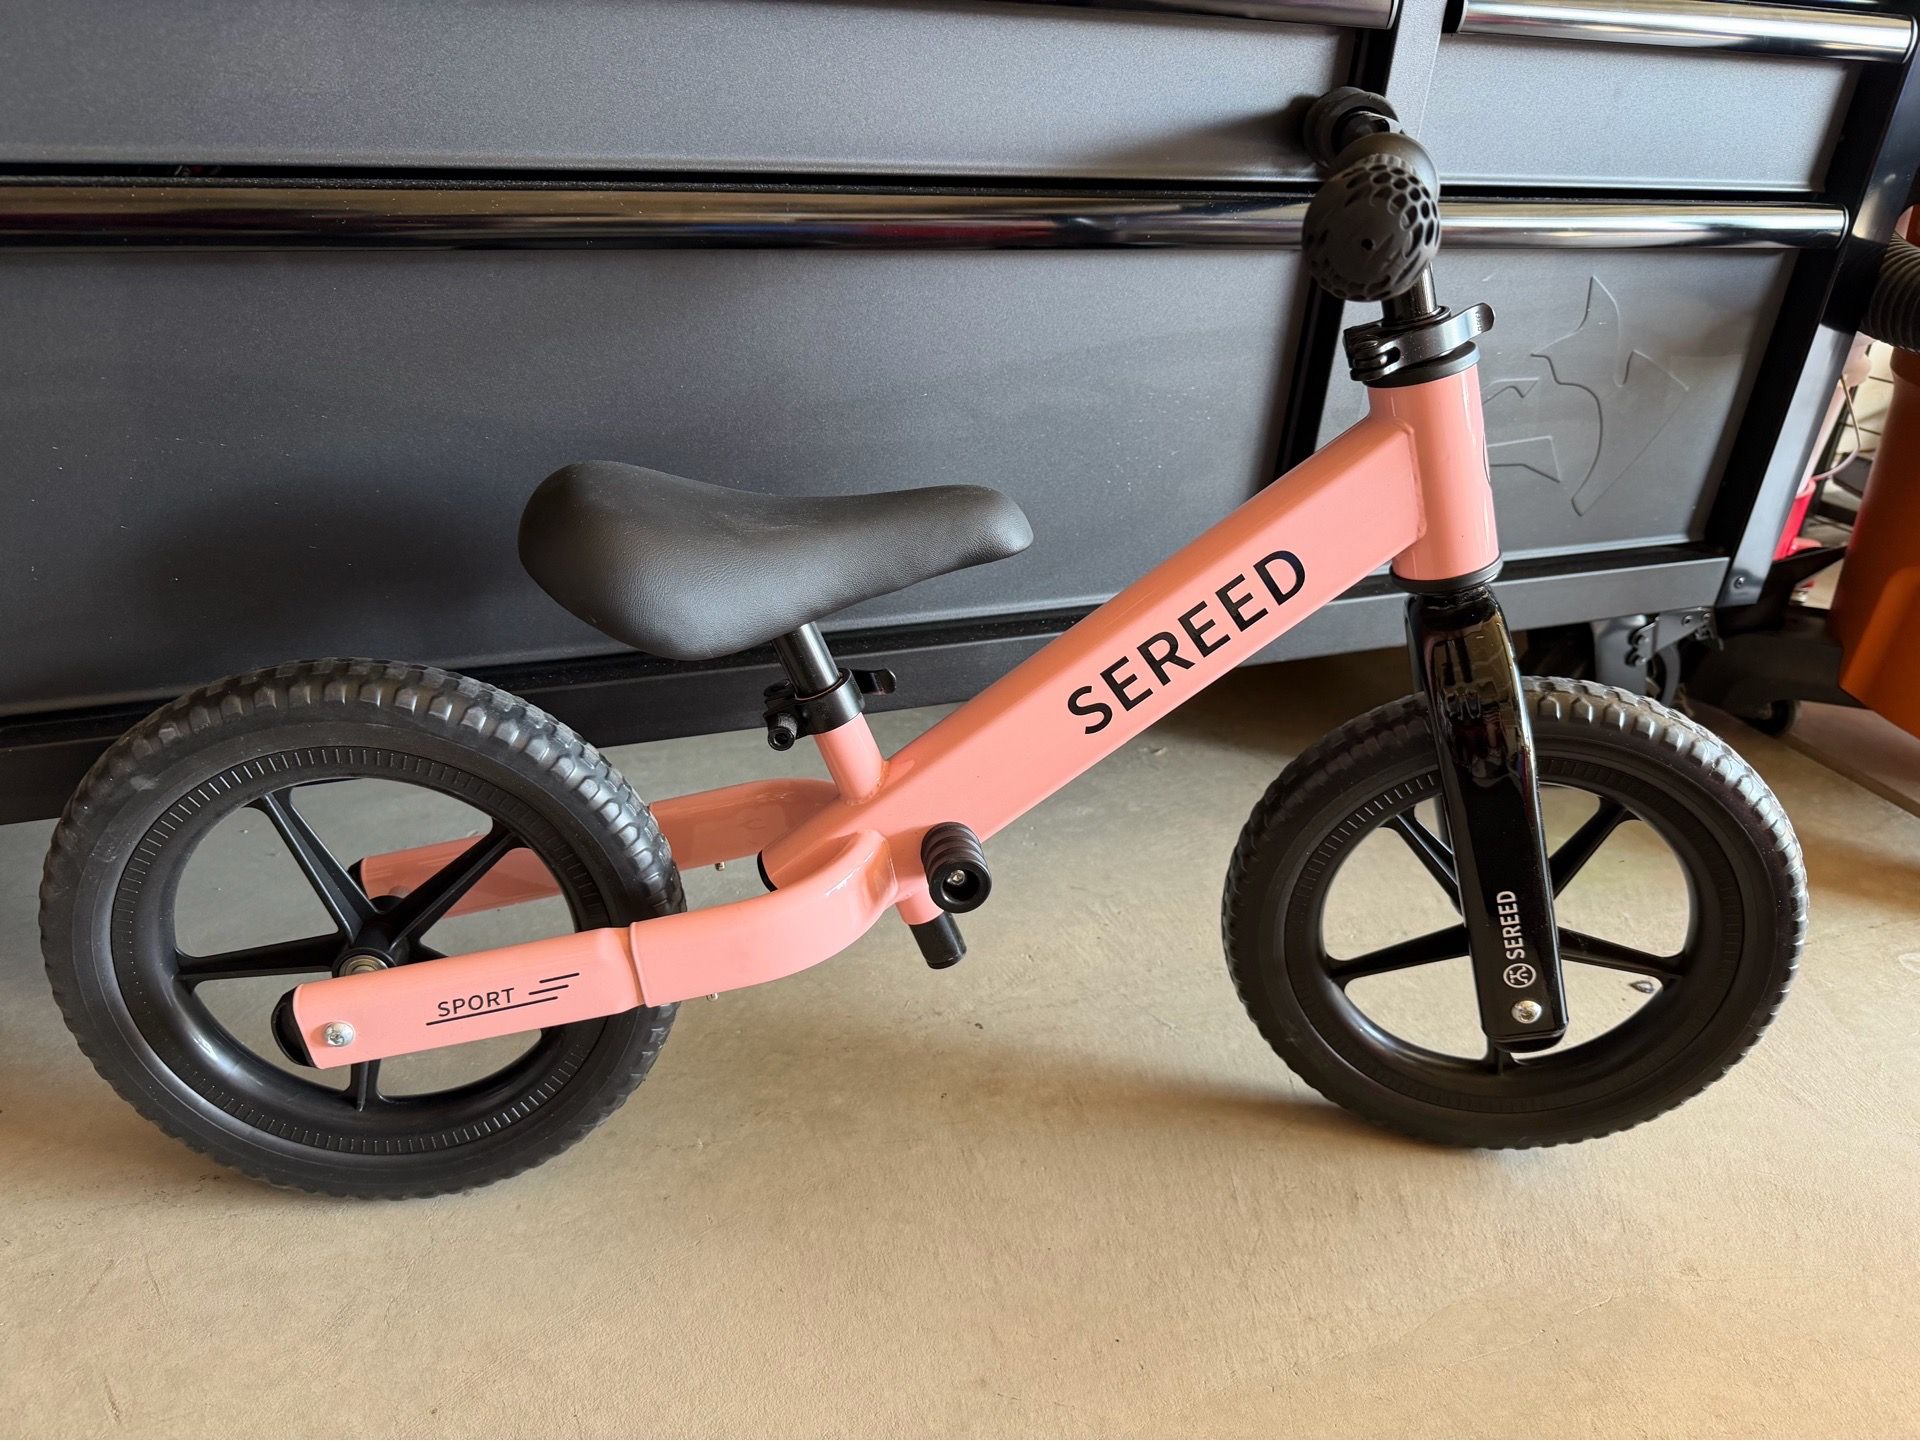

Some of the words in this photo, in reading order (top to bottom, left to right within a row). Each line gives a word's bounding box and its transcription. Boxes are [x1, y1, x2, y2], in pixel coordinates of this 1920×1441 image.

[1067, 550, 1306, 735] SEREED
[1496, 890, 1526, 960] SEREED
[437, 987, 515, 1017] SPORT
